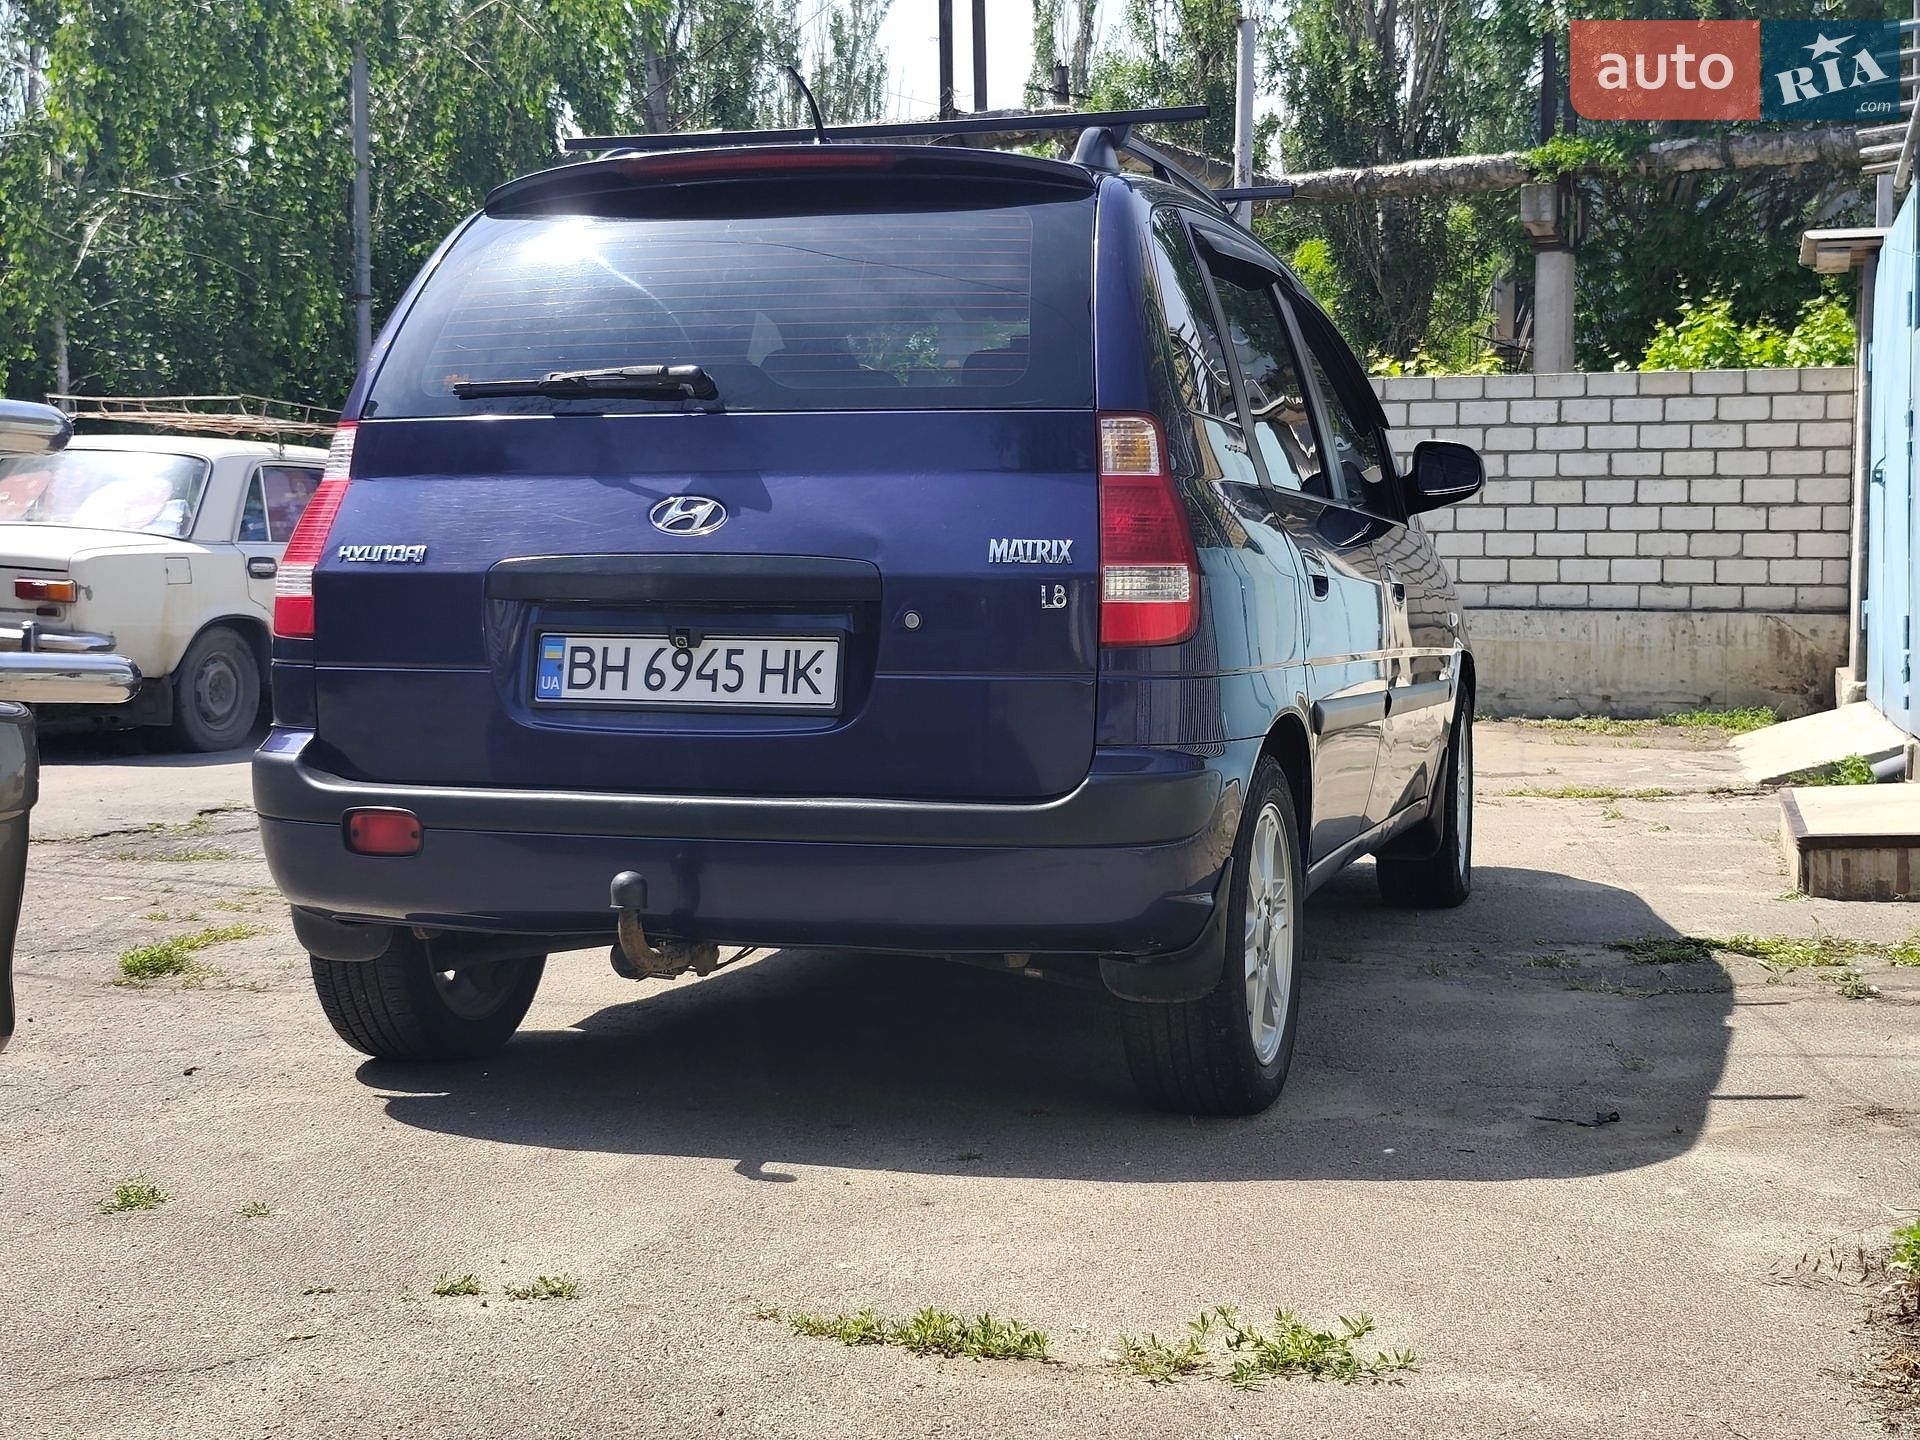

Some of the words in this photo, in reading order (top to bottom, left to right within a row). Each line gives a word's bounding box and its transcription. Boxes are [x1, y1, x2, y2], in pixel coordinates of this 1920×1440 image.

[338, 544, 428, 563] HYUNDAI
[988, 538, 1074, 564] MATRIX
[566, 645, 632, 692] BH
[643, 646, 745, 694] 6945
[758, 648, 825, 696] HK
[541, 675, 561, 691] UA
